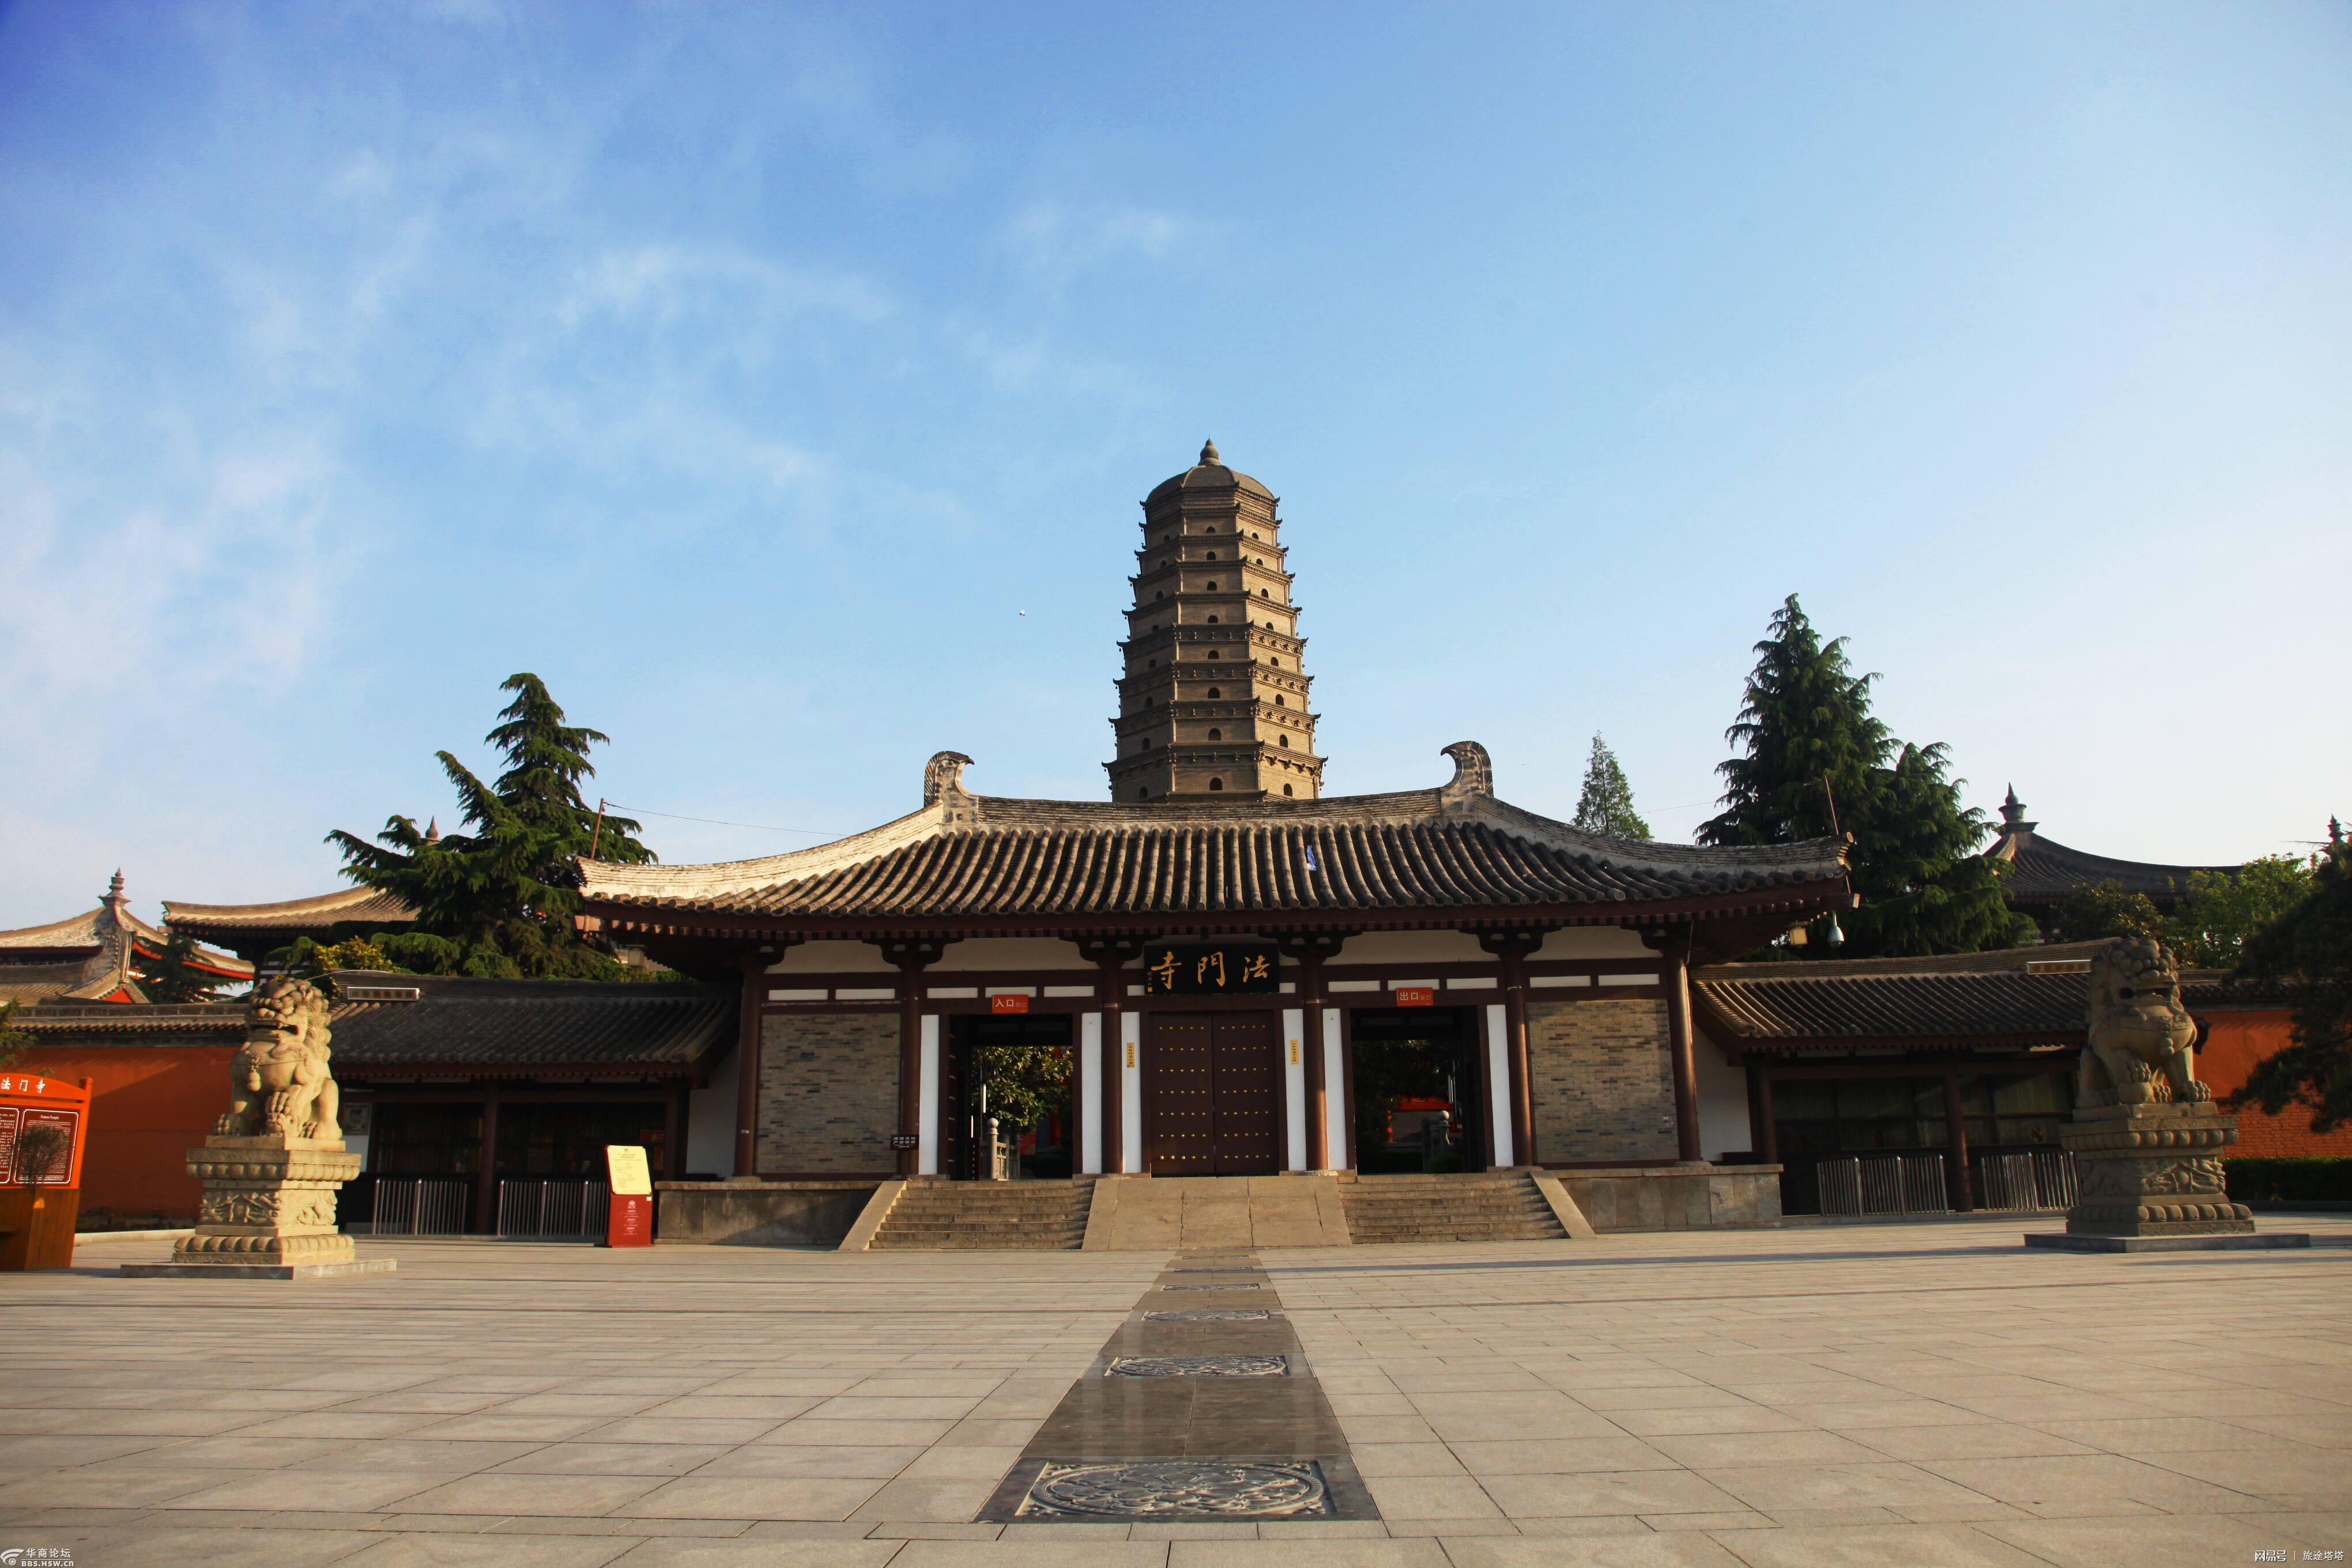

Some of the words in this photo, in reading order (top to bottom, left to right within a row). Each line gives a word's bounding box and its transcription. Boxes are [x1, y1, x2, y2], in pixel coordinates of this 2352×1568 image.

[1151, 951, 1271, 990] 法門寺
[1400, 992, 1418, 1001] 出口
[995, 999, 1014, 1008] 入口
[1, 1077, 46, 1094] 法门寺
